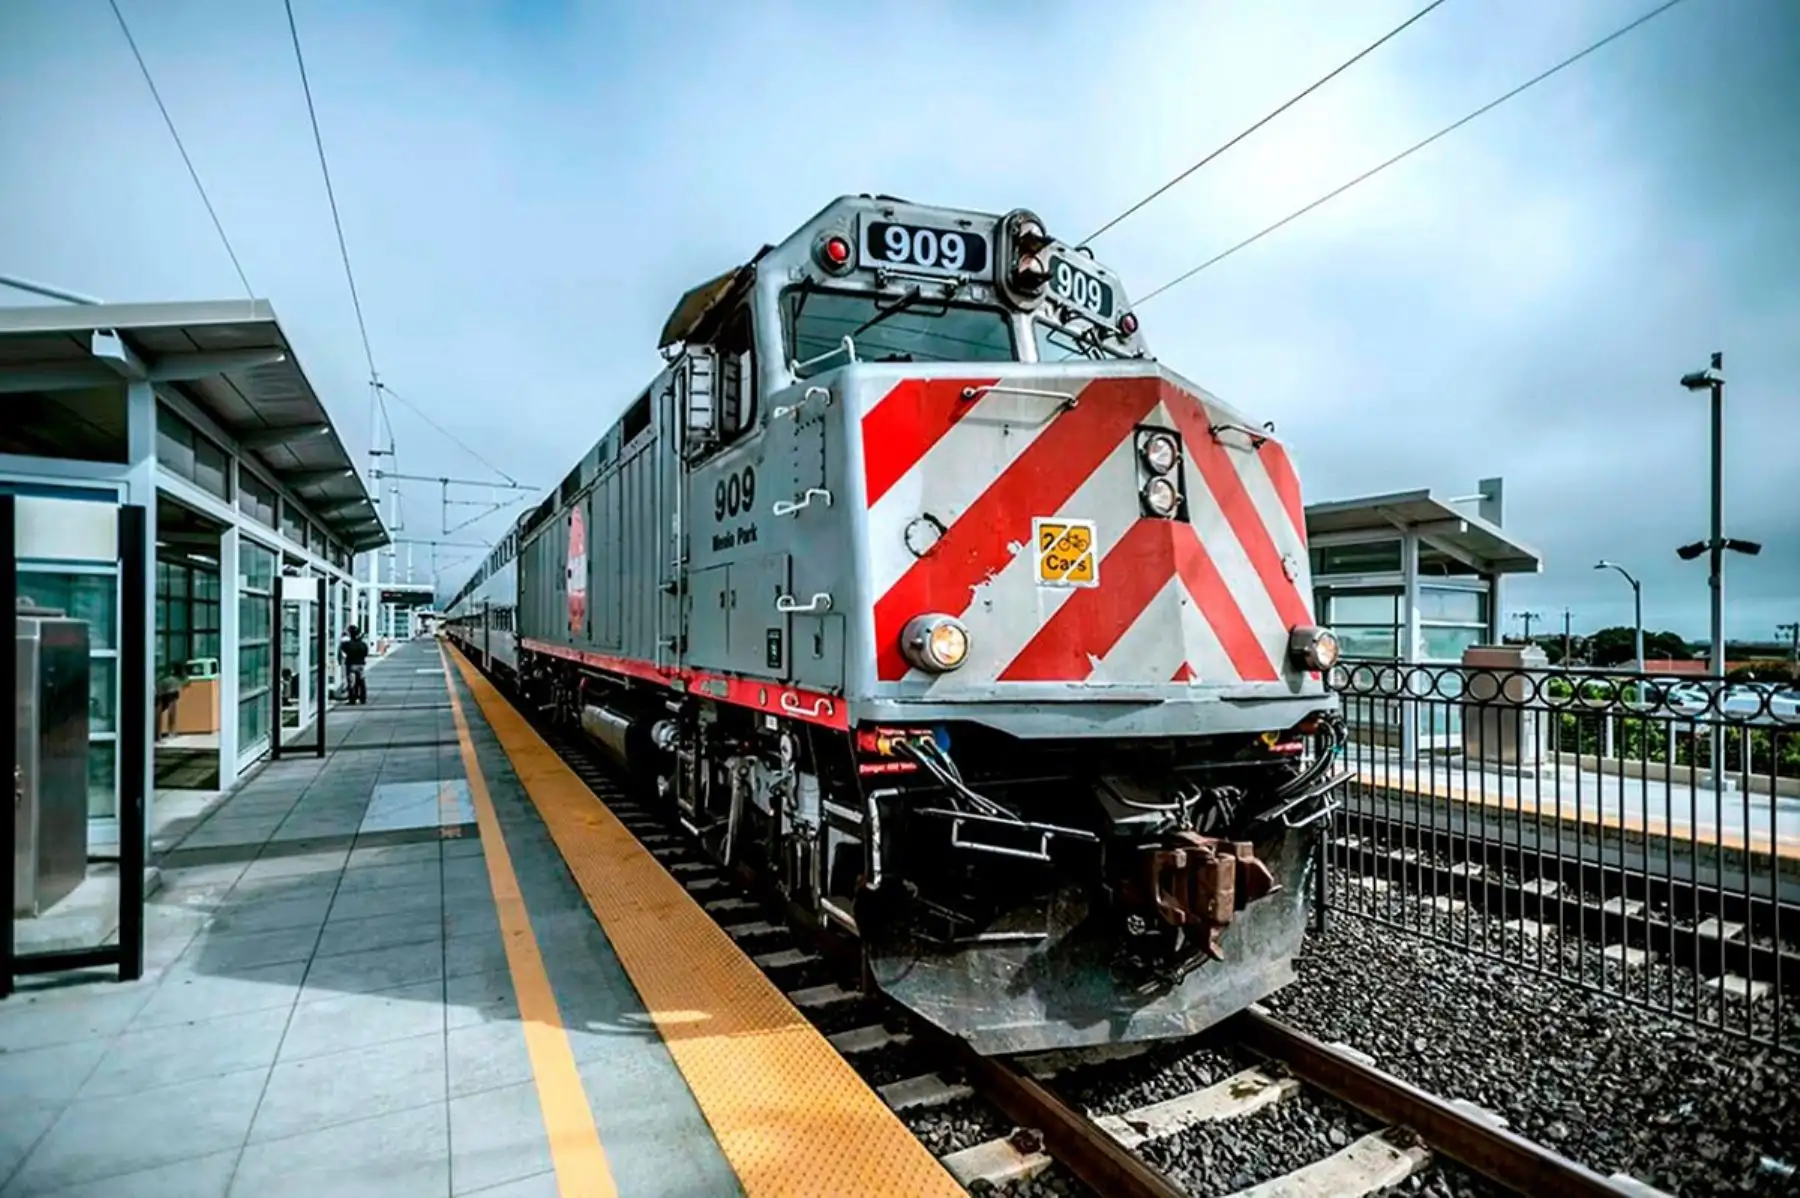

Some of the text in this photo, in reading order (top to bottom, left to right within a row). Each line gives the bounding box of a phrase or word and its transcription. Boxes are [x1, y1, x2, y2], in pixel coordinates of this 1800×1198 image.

[884, 225, 966, 271] 909
[1056, 262, 1102, 309] 909
[714, 465, 755, 522] 909
[1043, 532, 1056, 551] 2
[1046, 554, 1087, 572] Cars
